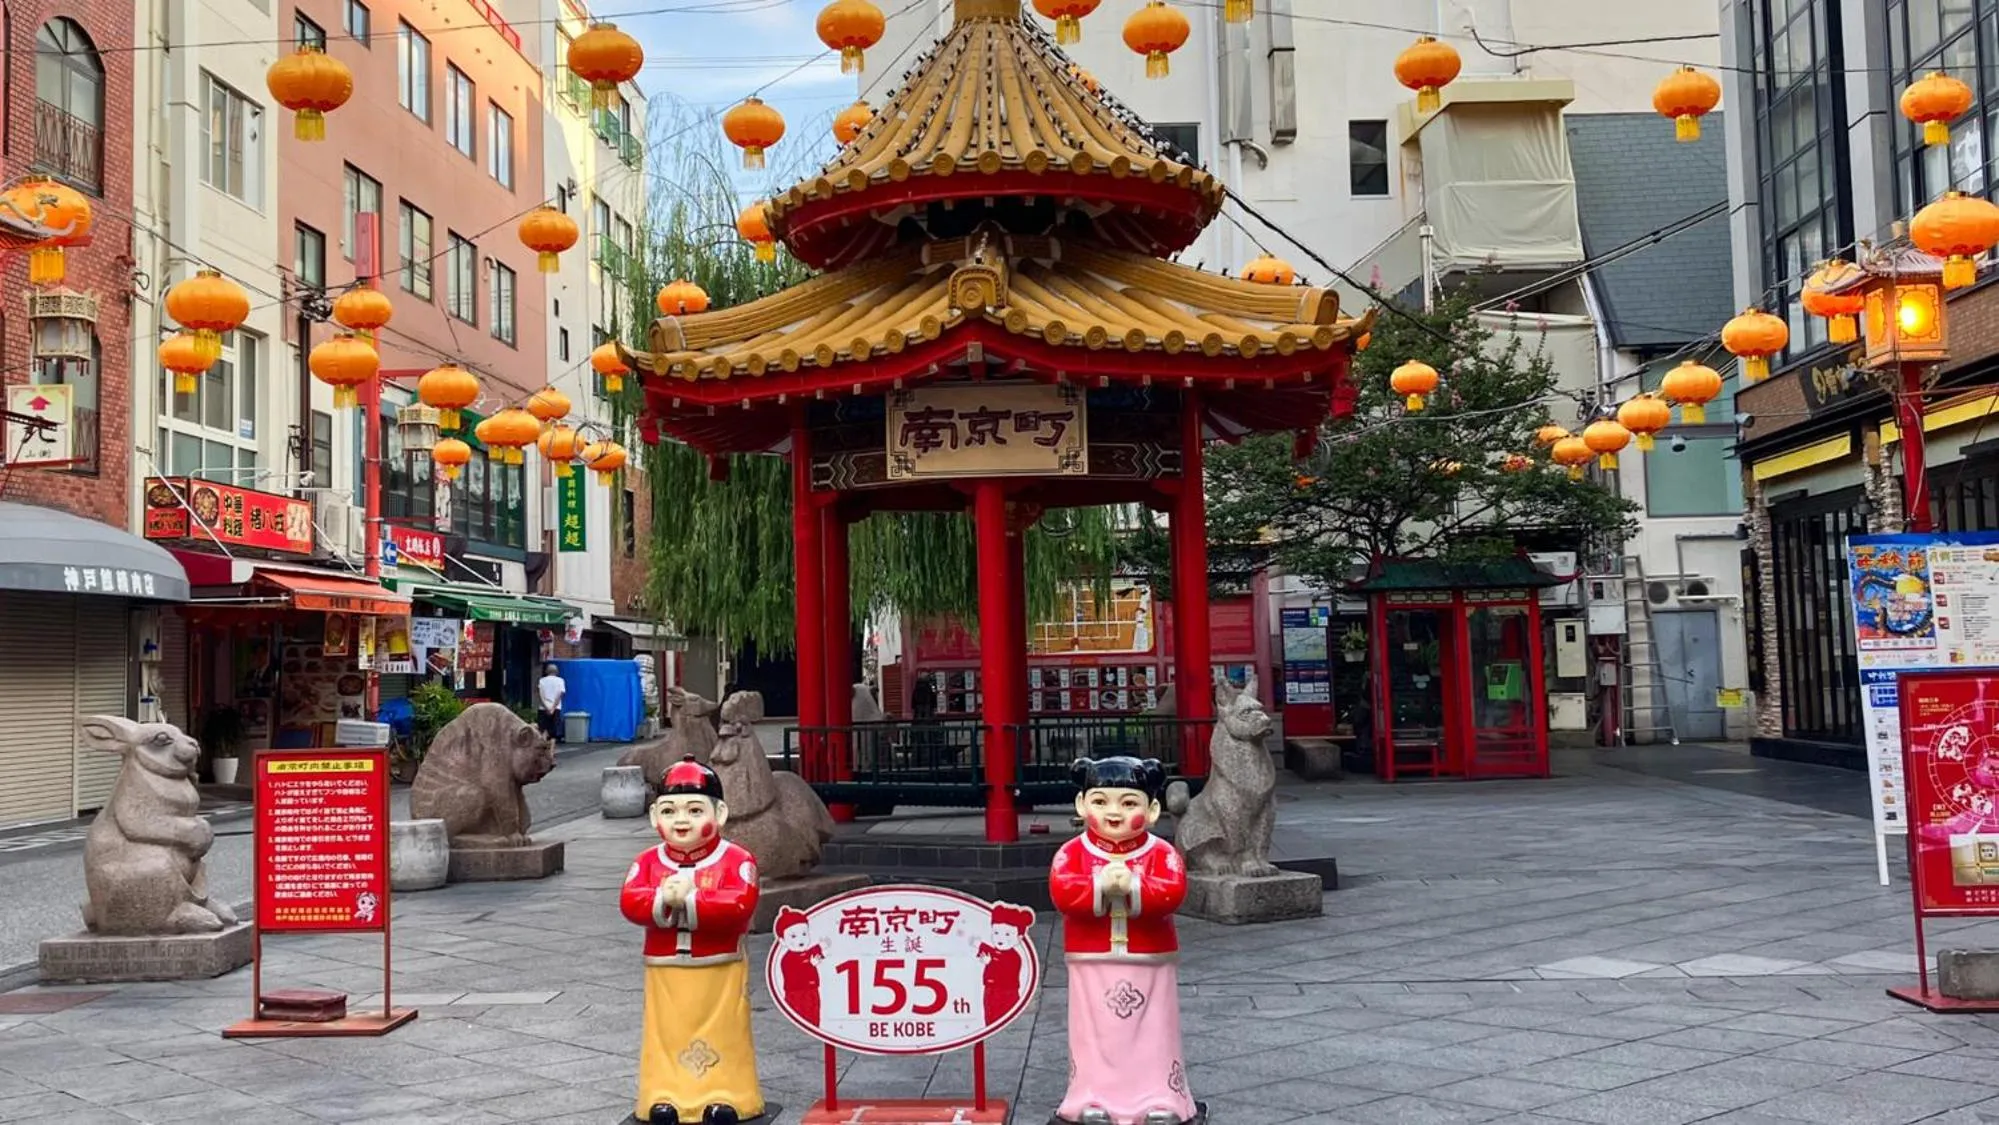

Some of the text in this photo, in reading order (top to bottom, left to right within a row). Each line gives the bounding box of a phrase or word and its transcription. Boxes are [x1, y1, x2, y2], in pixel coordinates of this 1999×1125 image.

[899, 405, 1074, 453] 南京町
[838, 905, 960, 938] 南京町
[880, 938, 924, 954] 生誕
[870, 1022, 936, 1038] BE KOBE
